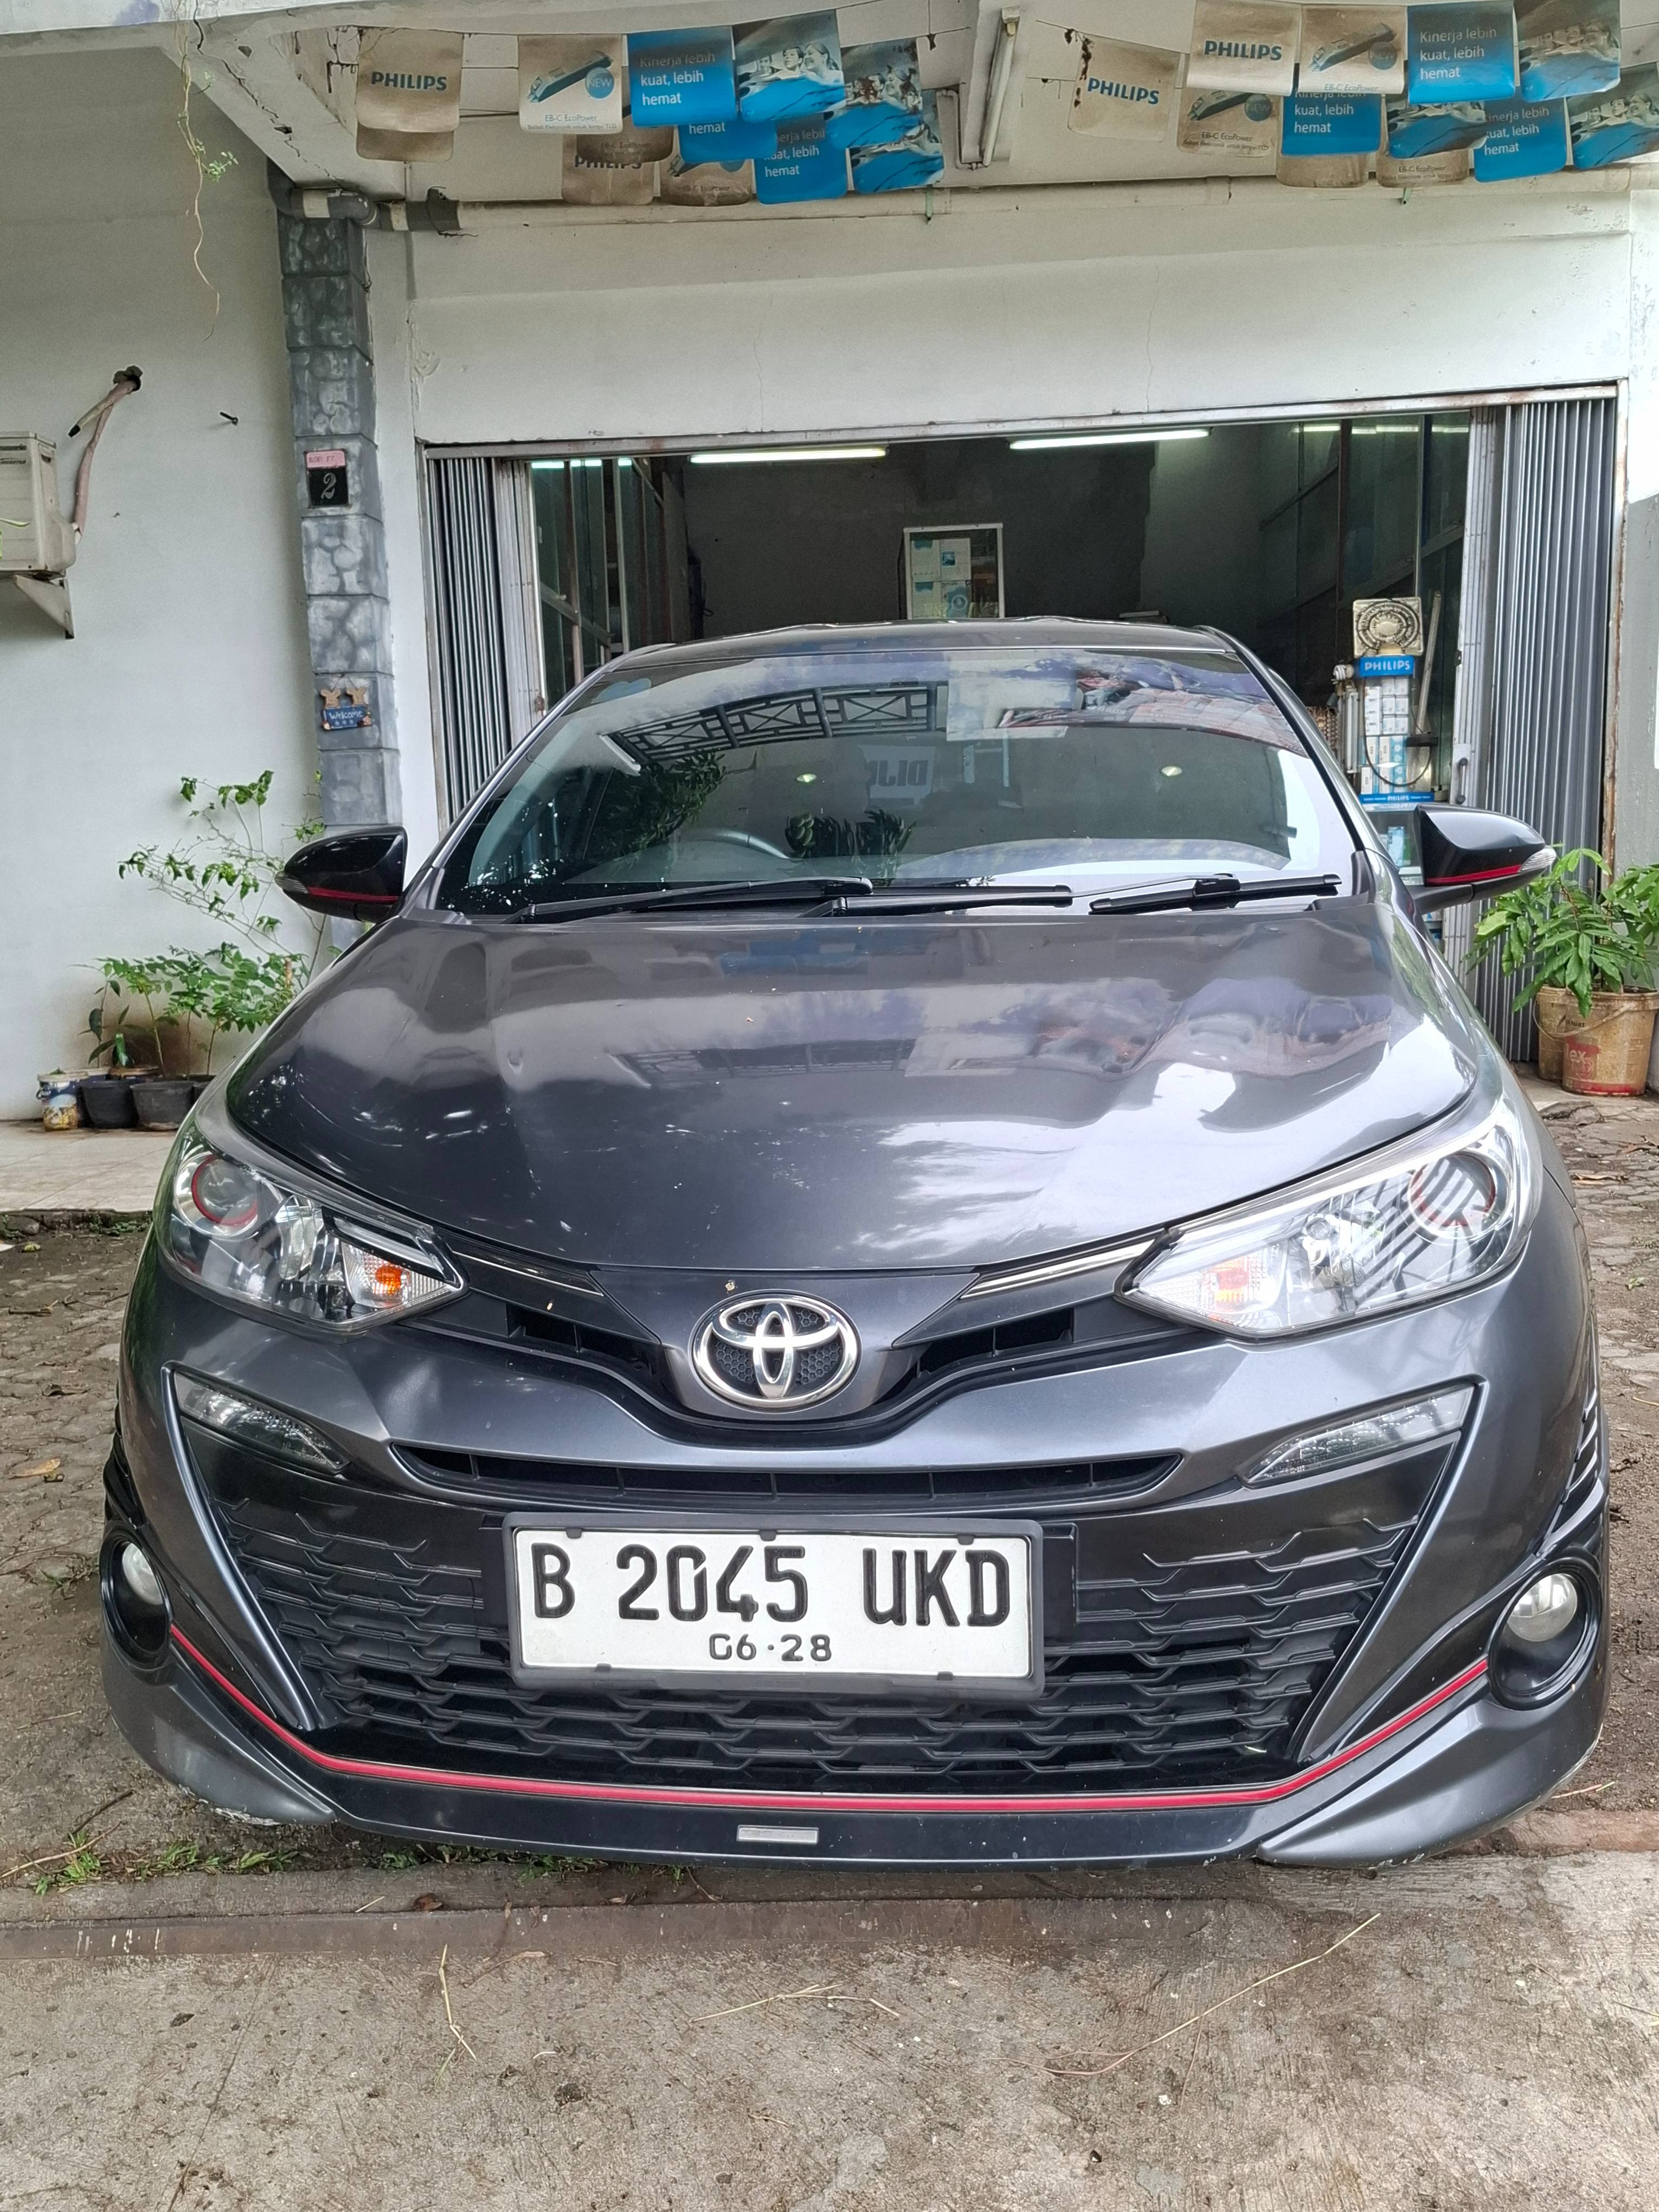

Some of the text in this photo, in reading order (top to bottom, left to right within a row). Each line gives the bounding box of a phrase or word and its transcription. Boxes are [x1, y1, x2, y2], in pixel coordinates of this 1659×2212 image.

[1420, 27, 1496, 43] Kinerja lebih
[1204, 40, 1282, 61] PHILIPS
[1420, 44, 1484, 61] kuat, lebih
[640, 53, 715, 68] Kinerja lebih
[641, 70, 704, 86] kuat, lebih
[1420, 66, 1461, 80] hemat
[371, 71, 447, 91] PHILIPS
[587, 78, 613, 87] NEW
[1087, 78, 1160, 105] PHILIPS
[642, 92, 681, 106] hemat
[1295, 104, 1354, 117] kuat, lebih
[1522, 107, 1549, 119] lebih
[545, 114, 562, 122] EB-C
[689, 122, 725, 134] hemat
[1294, 121, 1332, 133] hemat
[1512, 124, 1539, 136] lebih
[780, 131, 800, 144] erja
[764, 145, 820, 160] uat, lebih
[1484, 144, 1520, 156] hemat
[764, 165, 800, 177] hemat
[321, 473, 336, 499] 2
[1364, 660, 1410, 671] PHILIPS
[531, 1542, 1010, 1628] B 2045 UKD
